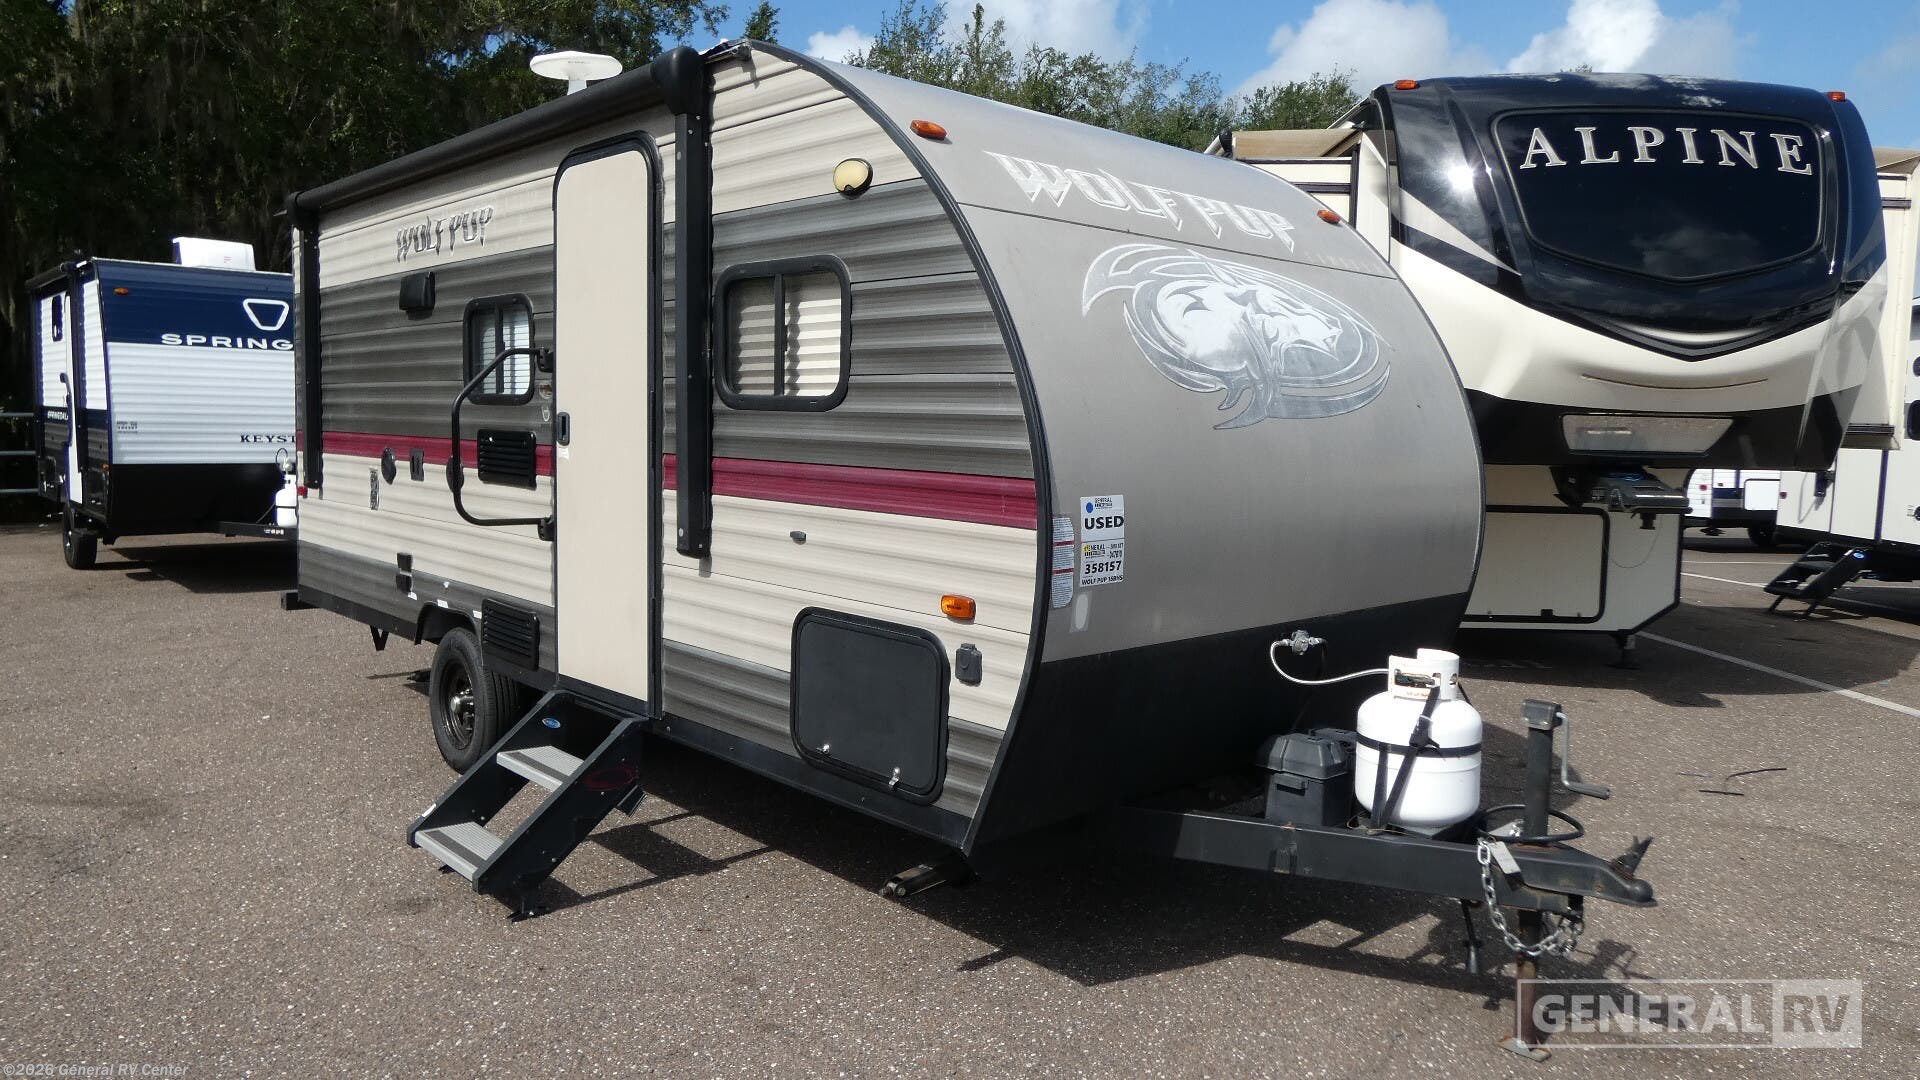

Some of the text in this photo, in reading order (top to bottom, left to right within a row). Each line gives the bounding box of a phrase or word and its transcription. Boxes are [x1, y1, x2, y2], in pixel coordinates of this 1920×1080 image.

[1519, 126, 1813, 176] ALPINE
[983, 151, 1295, 254] WOLF PUP
[397, 207, 494, 263] WOLF PUP
[161, 333, 294, 350] SPRING
[1085, 516, 1124, 530] USED
[1085, 561, 1121, 574] 358157
